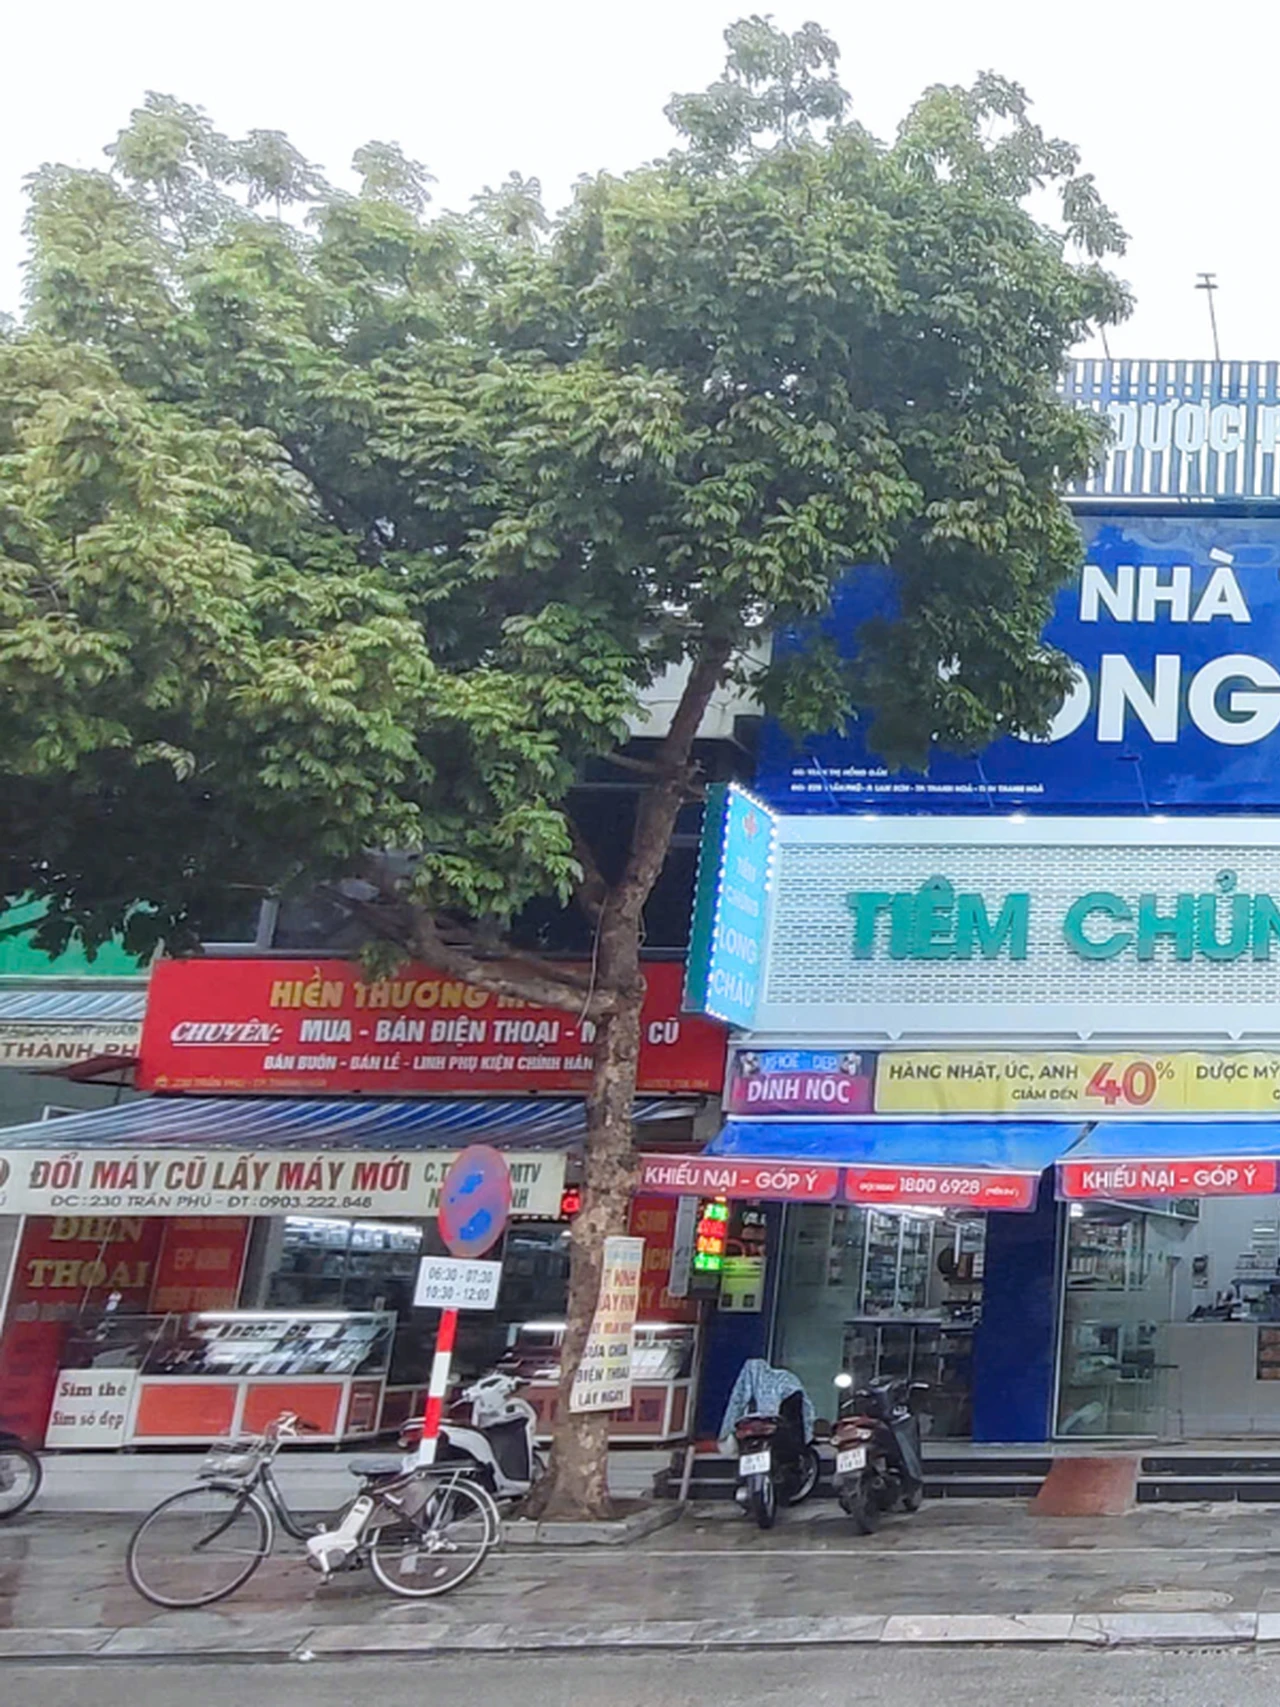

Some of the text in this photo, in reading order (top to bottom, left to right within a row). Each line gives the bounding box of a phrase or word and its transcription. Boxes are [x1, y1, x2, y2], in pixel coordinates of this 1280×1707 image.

[1080, 547, 1252, 622] NHÀ
[847, 872, 1030, 961] TIÊM
[720, 922, 757, 965] LONG
[300, 1018, 353, 1043] MUA
[375, 1013, 425, 1043] BÁN
[430, 1014, 487, 1048] ĐIỆN
[494, 1019, 560, 1048] THOẠI
[648, 1016, 679, 1045] CŨ
[1, 1037, 95, 1059] THÀNH
[563, 1055, 595, 1071] HÀN
[889, 1062, 941, 1079] HÀNG
[1038, 1064, 1079, 1079] ANH
[1196, 1064, 1248, 1083] DƯỢC
[29, 1152, 412, 1191] ĐỔI MÁY CŨ LẤY MÁY MỚI
[702, 1168, 738, 1193] NẠI
[755, 1167, 800, 1191] GÓP
[804, 1168, 819, 1192] Ý
[1141, 1170, 1176, 1193] NẠI
[1193, 1165, 1239, 1187] GÓP
[1243, 1164, 1258, 1186] Ý
[900, 1177, 936, 1193] 1800
[939, 1178, 981, 1195] 6928
[60, 1381, 93, 1397] Sim
[52, 1410, 77, 1426] Sim
